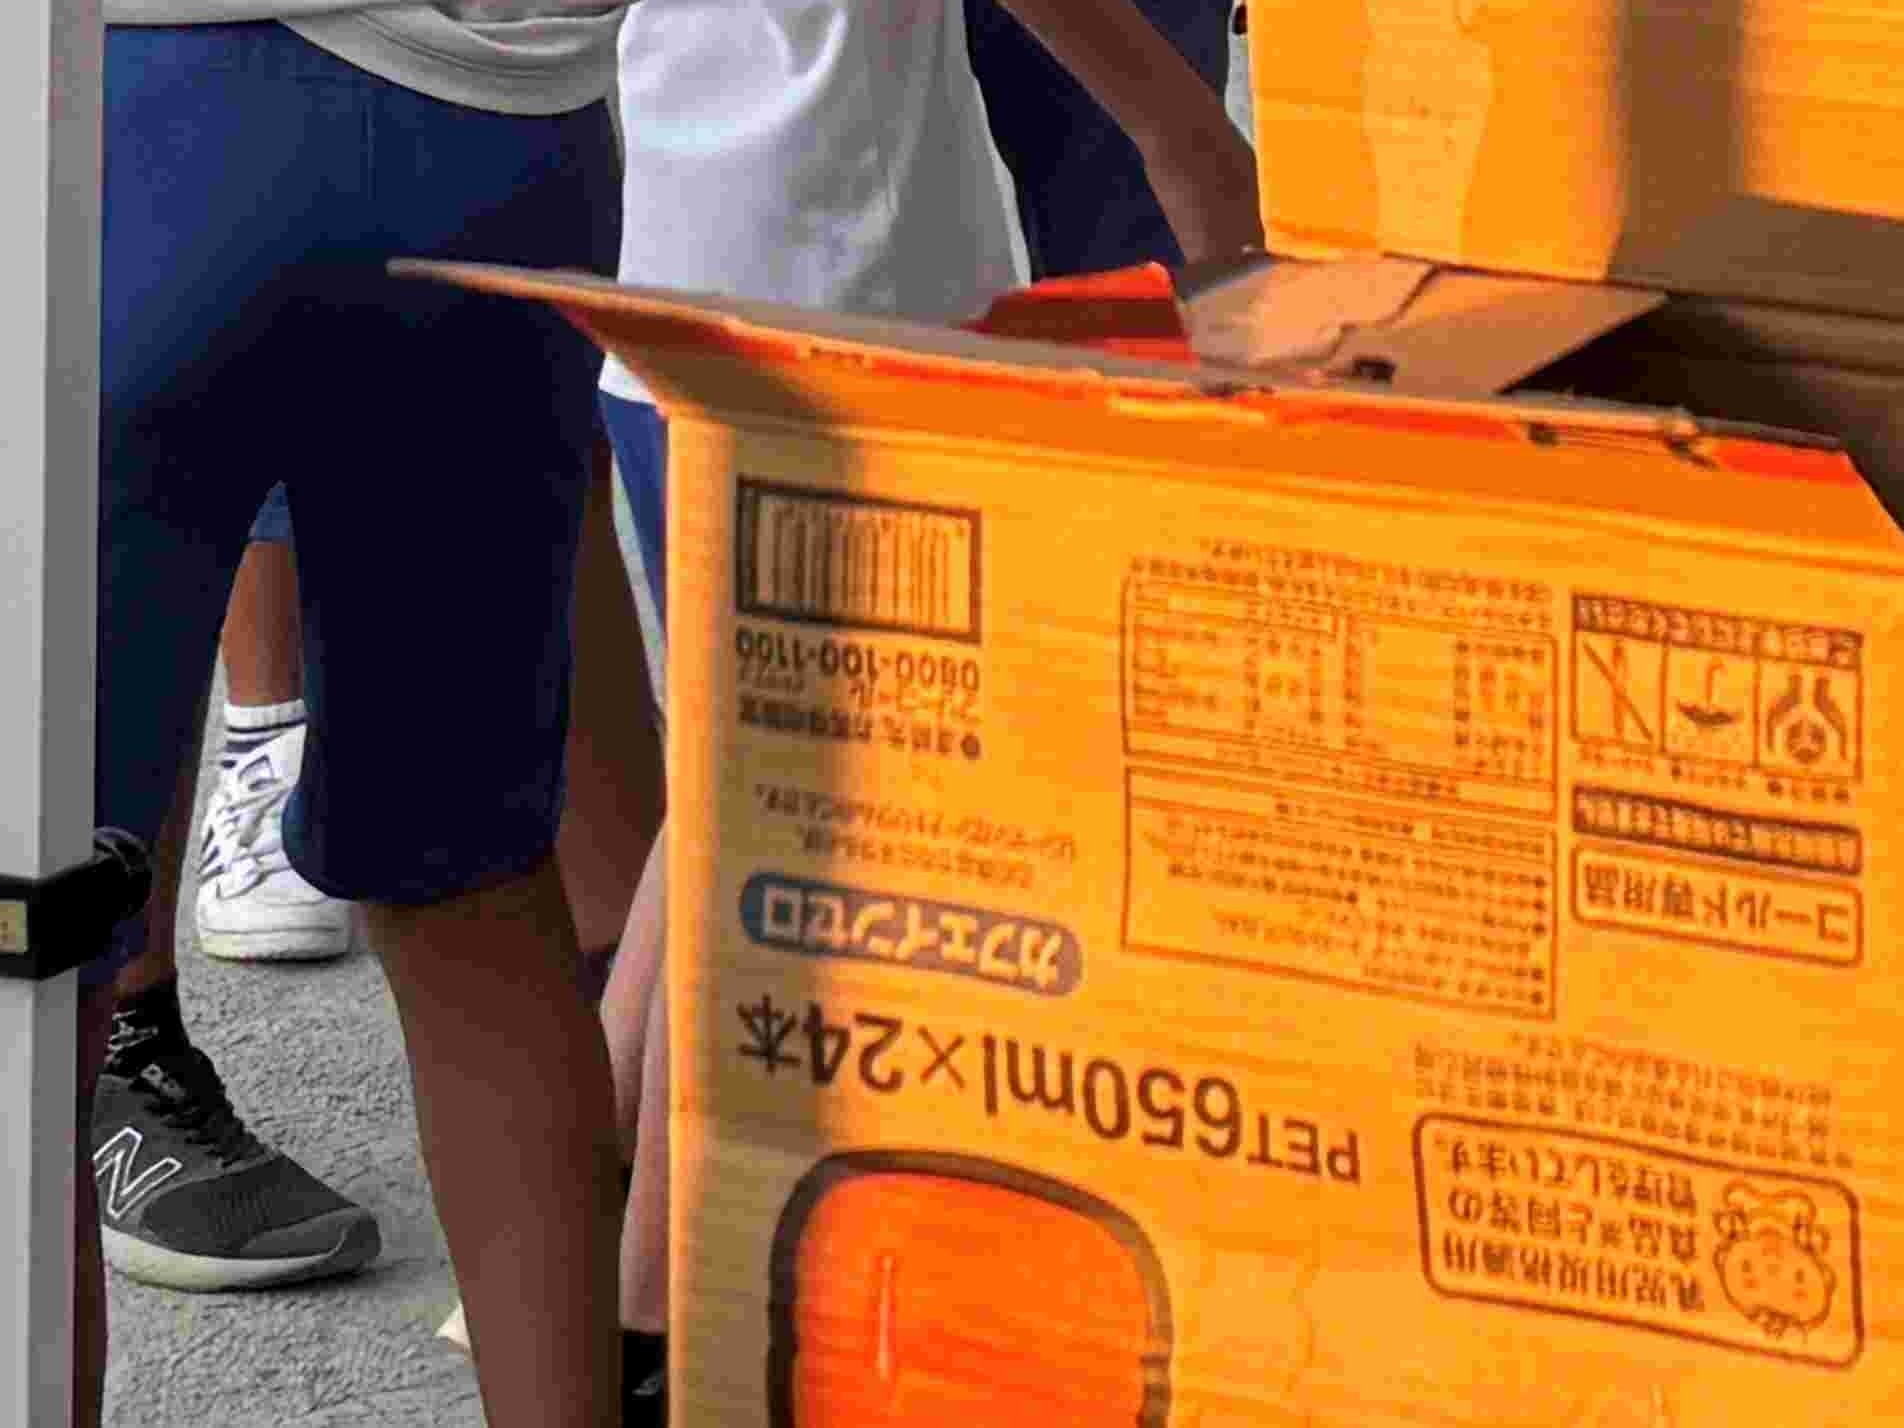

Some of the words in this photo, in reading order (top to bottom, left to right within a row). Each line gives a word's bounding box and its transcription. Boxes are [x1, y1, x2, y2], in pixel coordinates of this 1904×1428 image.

[735, 629, 982, 694] 0800-100-1100
[762, 885, 1064, 991] カフェインゼロ
[1583, 864, 1849, 944] コールド専用品
